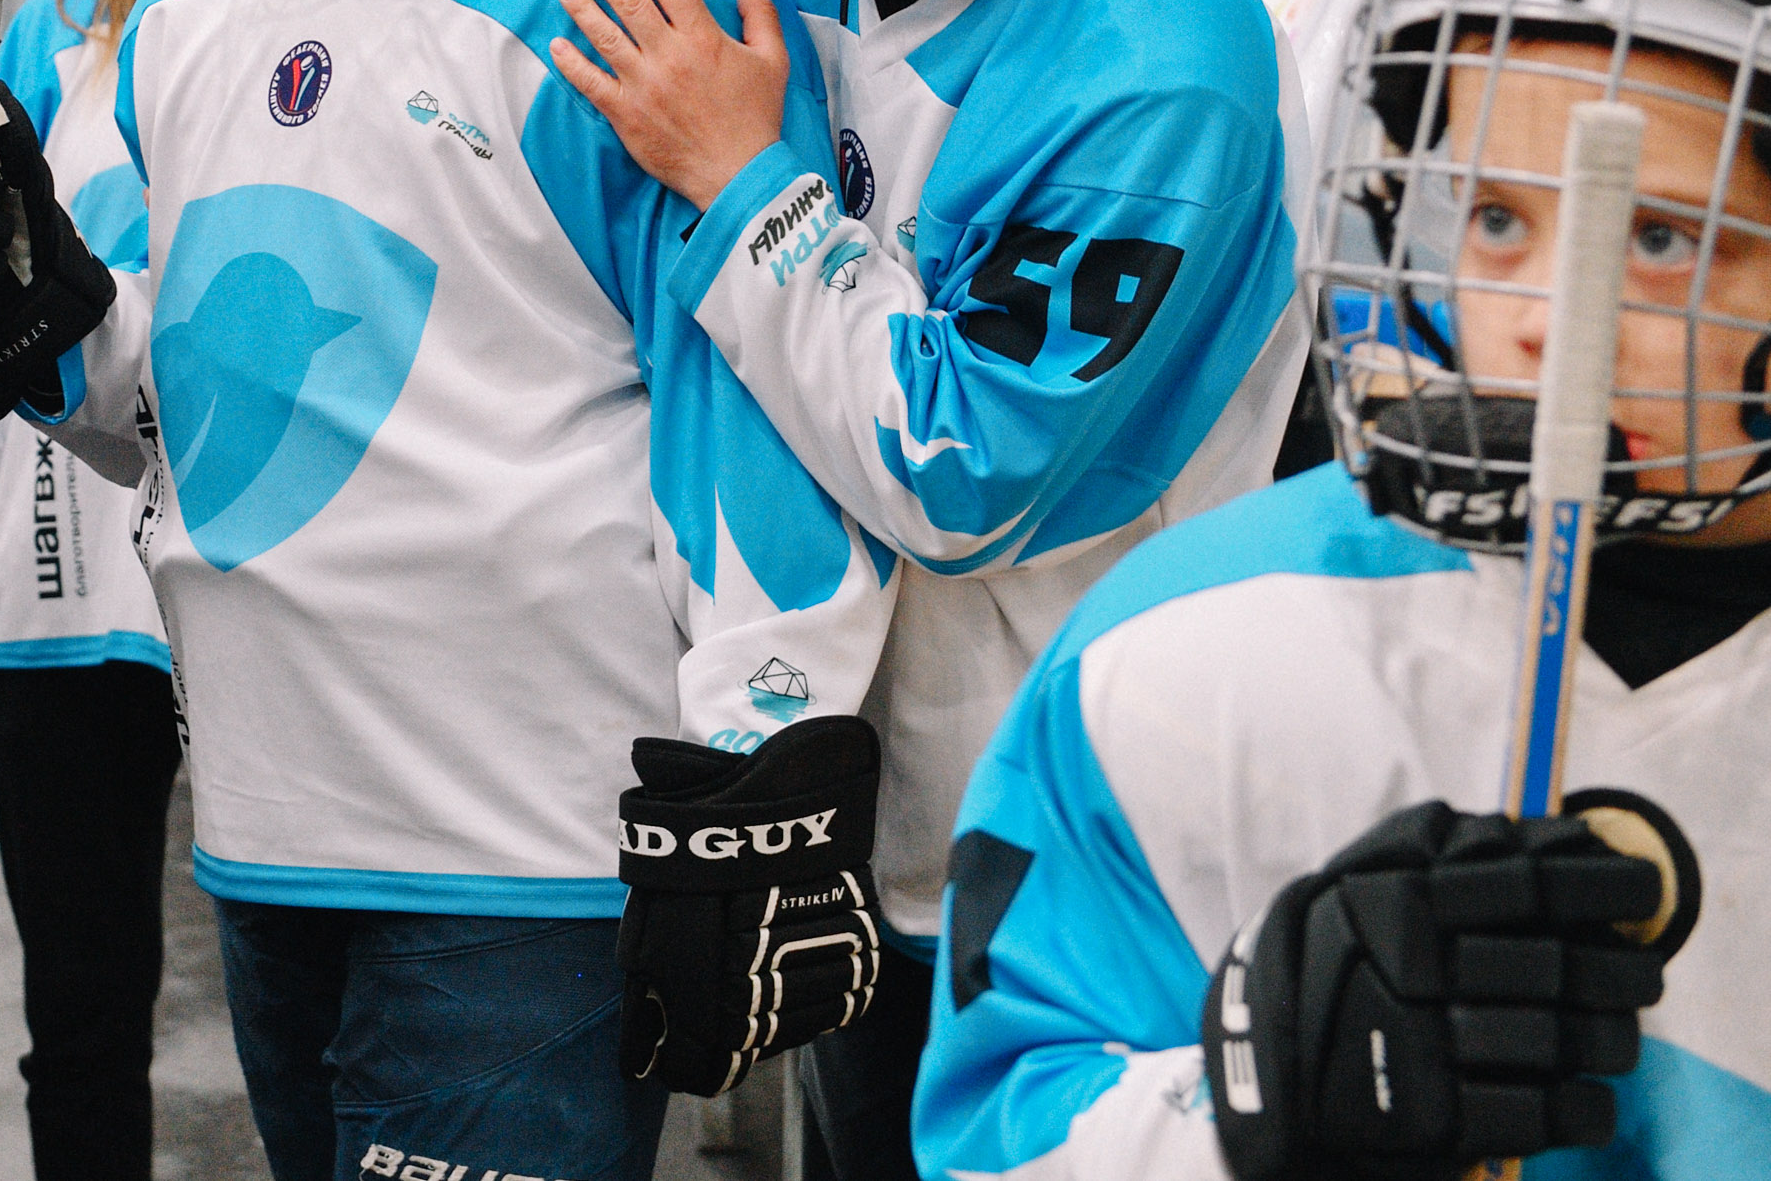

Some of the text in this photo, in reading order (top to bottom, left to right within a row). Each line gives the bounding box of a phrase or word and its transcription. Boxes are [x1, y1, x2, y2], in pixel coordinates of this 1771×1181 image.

[958, 224, 1185, 382] 59
[34, 434, 64, 599] шагвж
[688, 808, 838, 860] GUY
[781, 886, 846, 909] STRIKE IV
